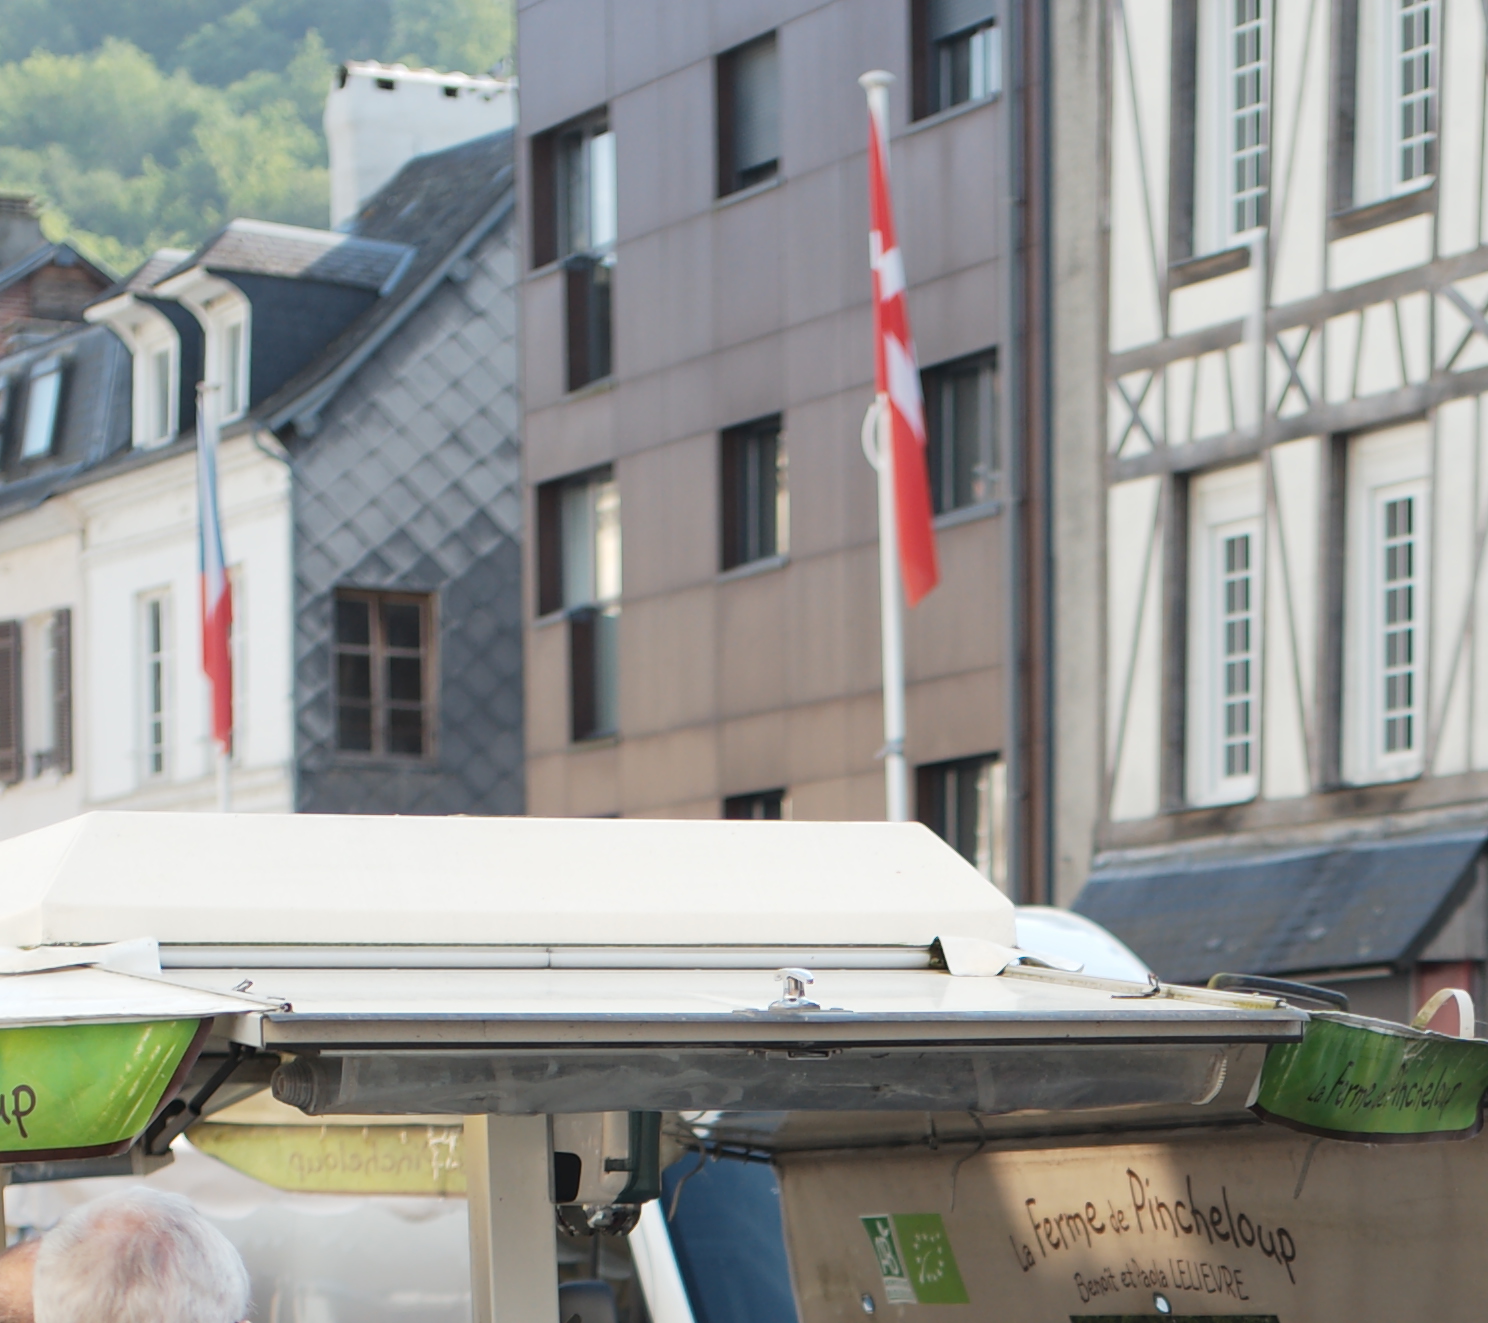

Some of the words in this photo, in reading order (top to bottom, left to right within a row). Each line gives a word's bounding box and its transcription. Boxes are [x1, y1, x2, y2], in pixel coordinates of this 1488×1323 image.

[1009, 1234, 1036, 1273] La
[1025, 1198, 1106, 1258] Ferme
[1108, 1200, 1130, 1236] de
[1126, 1166, 1296, 1285] Pincheloup
[1121, 1257, 1137, 1290] et
